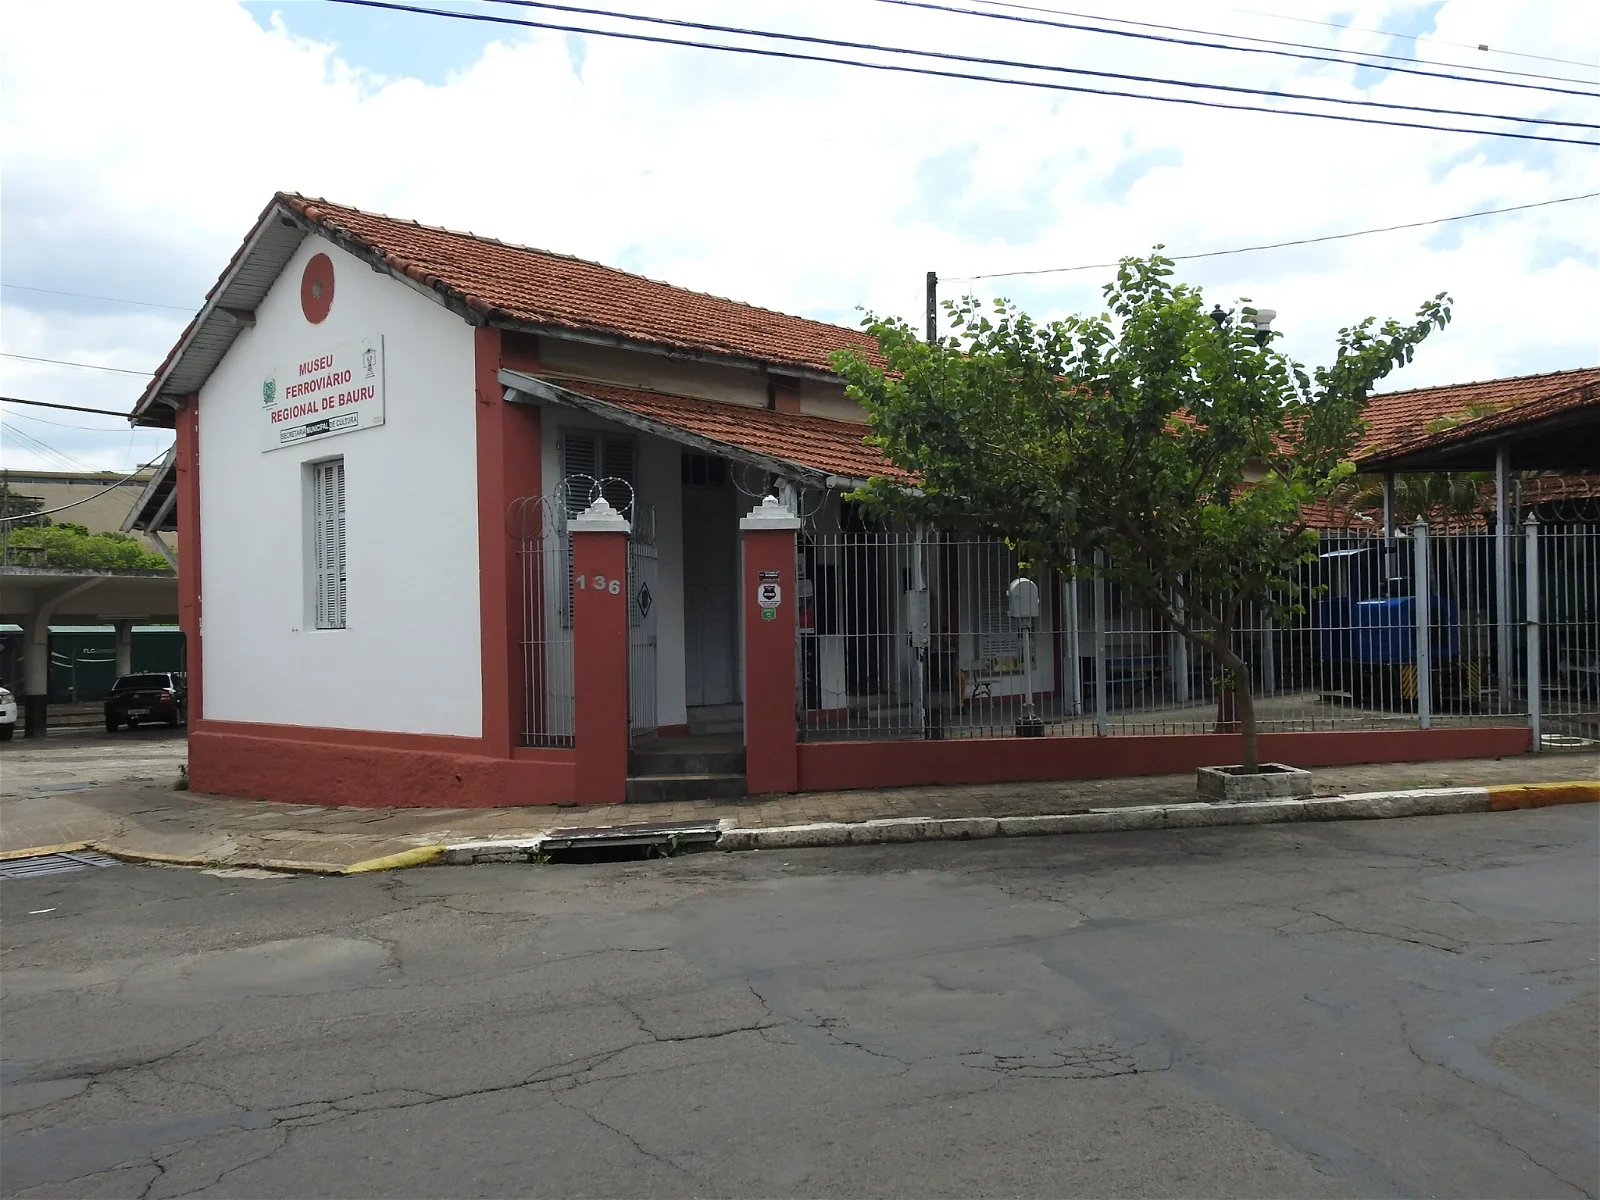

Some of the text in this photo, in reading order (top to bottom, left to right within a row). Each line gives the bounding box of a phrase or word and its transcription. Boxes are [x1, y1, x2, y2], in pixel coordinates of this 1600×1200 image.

[299, 354, 333, 376] MUSEU
[285, 370, 351, 399] FERROVIÁRIO
[271, 400, 319, 424] REGIONAL
[321, 395, 335, 411] DE
[338, 385, 375, 407] BAURU
[329, 420, 336, 428] DE
[336, 415, 357, 427] CULTURA
[576, 574, 621, 595] 136
